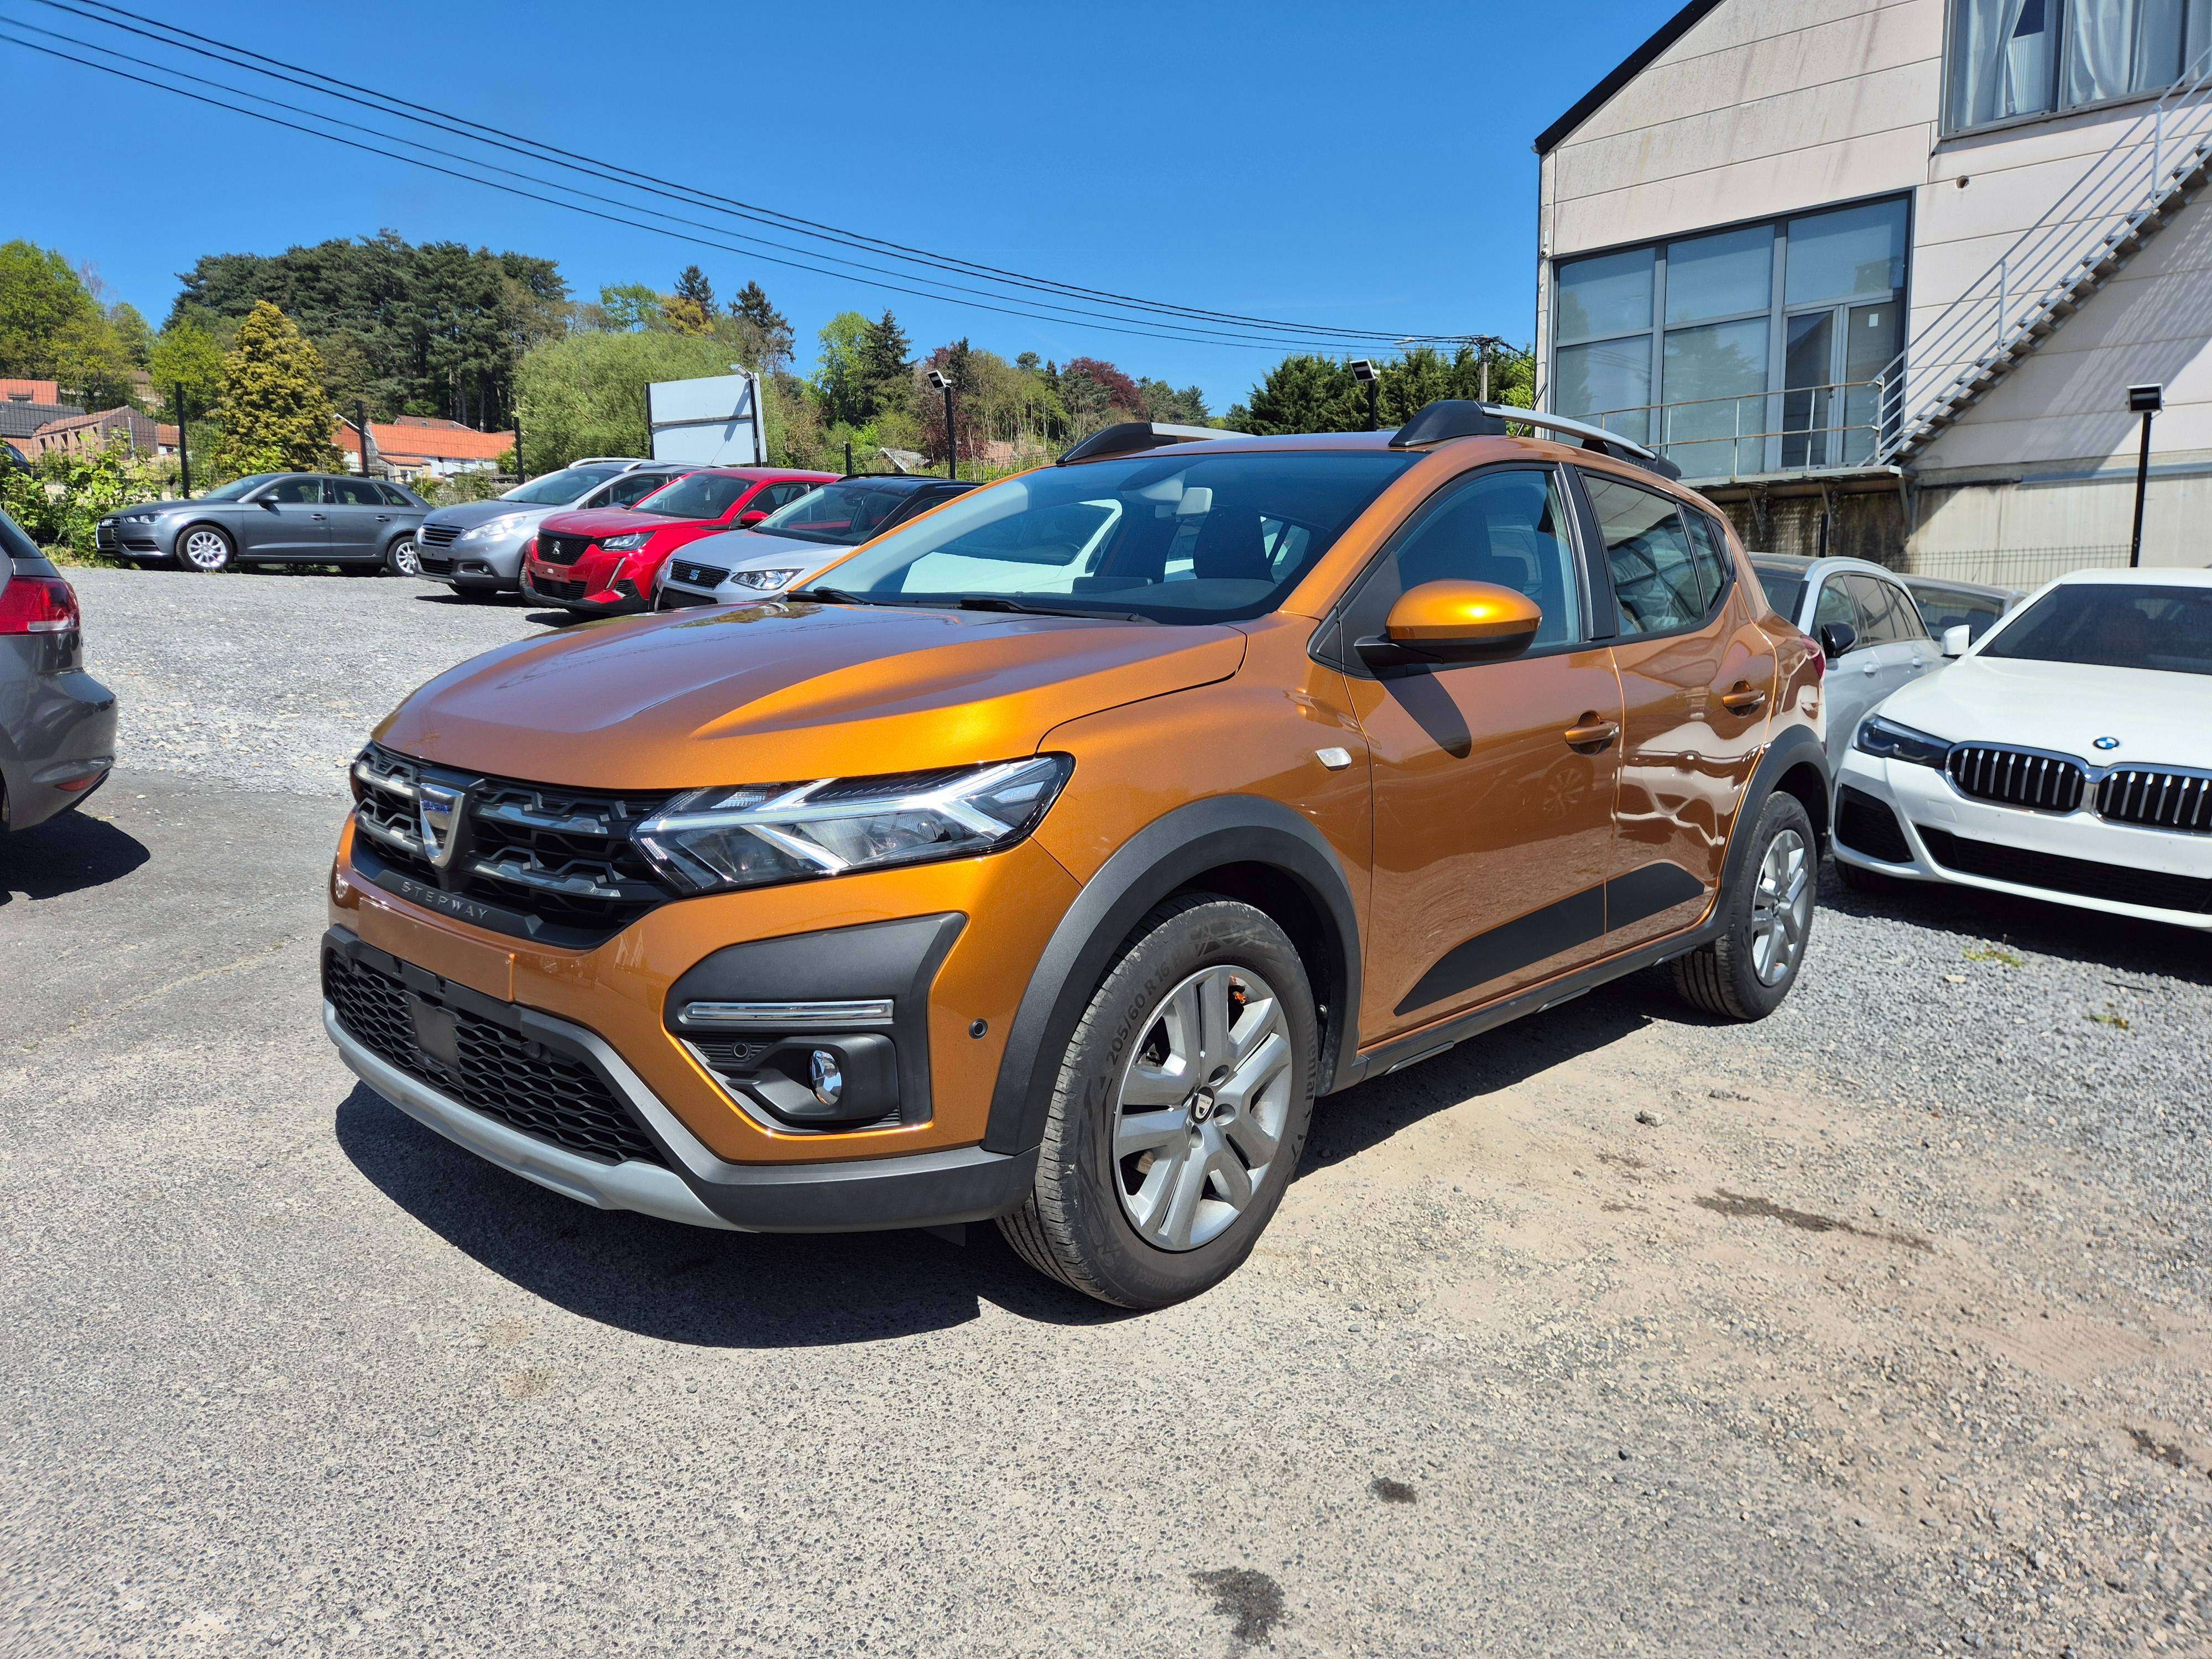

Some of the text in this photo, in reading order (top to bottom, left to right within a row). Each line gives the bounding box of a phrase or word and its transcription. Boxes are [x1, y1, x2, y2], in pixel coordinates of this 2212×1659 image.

[401, 881, 488, 919] STEPWAY
[1106, 962, 1170, 1066] 205/60 R 16
